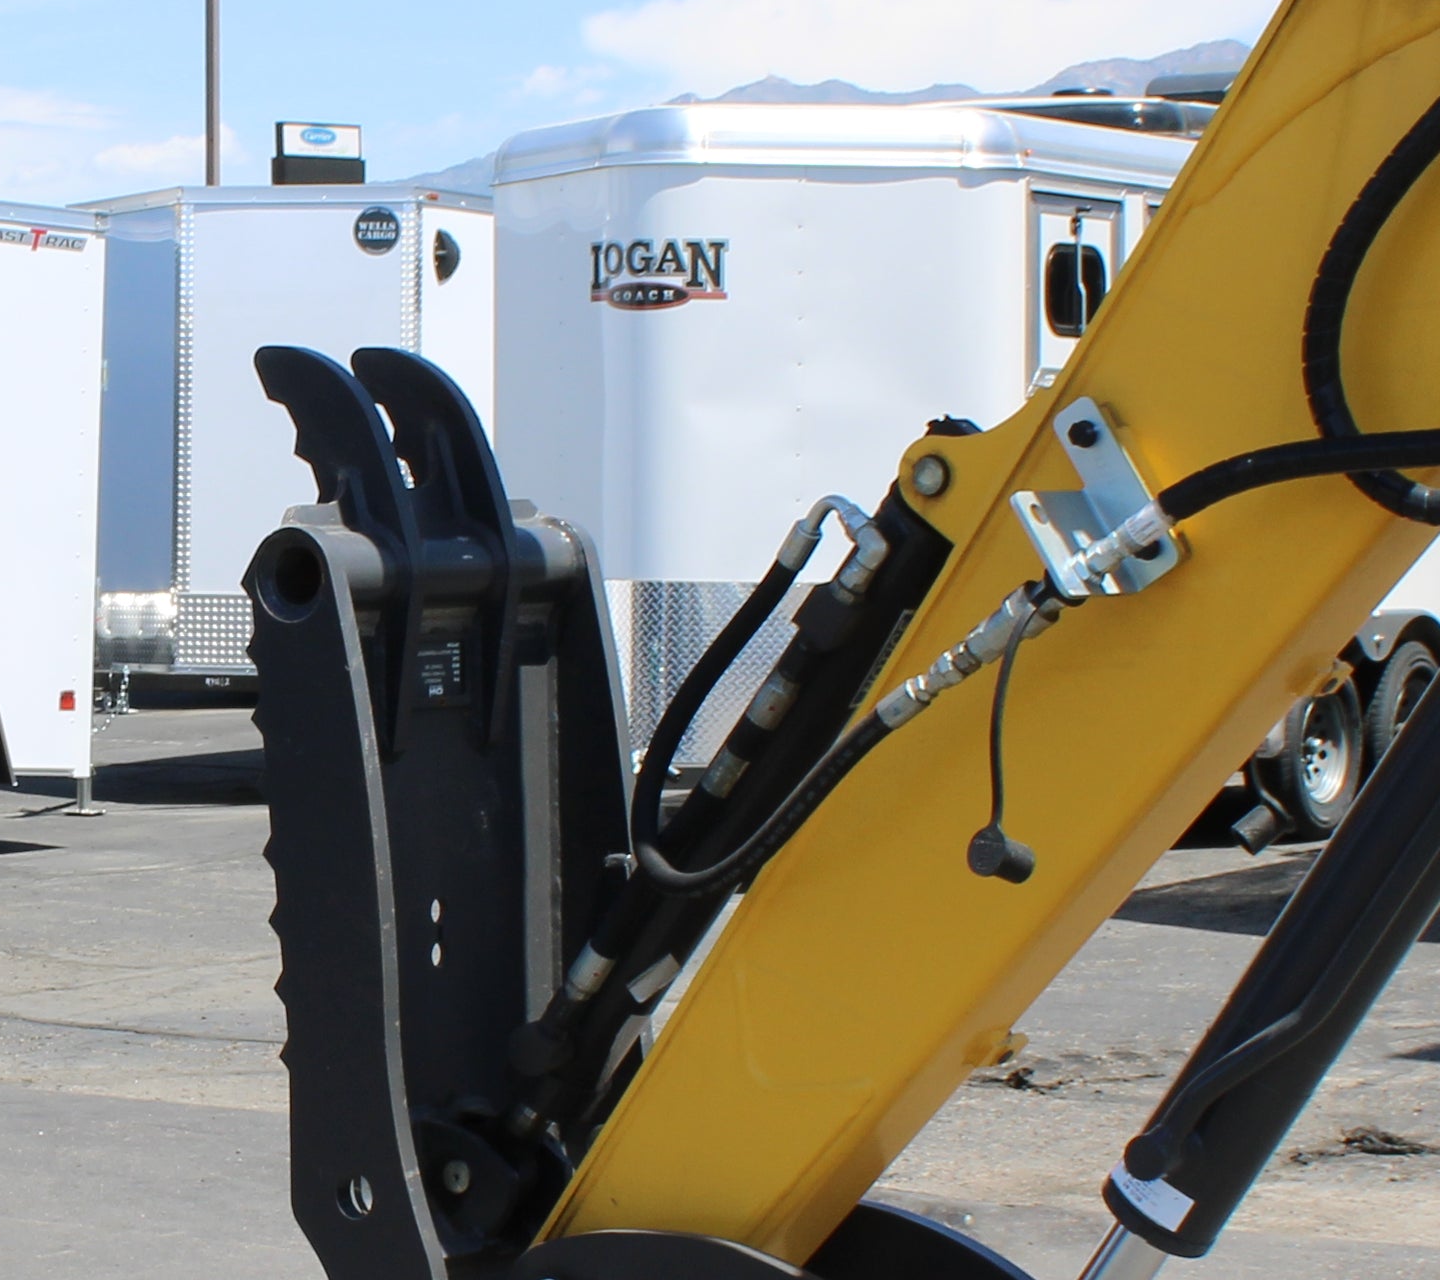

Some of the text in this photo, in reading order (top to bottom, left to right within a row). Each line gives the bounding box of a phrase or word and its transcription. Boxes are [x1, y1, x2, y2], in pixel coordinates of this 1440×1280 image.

[358, 221, 396, 230] WELLS
[30, 228, 83, 251] TRAC
[358, 230, 396, 240] CARGO
[591, 239, 727, 291] LOGAN
[612, 289, 675, 302] COACH
